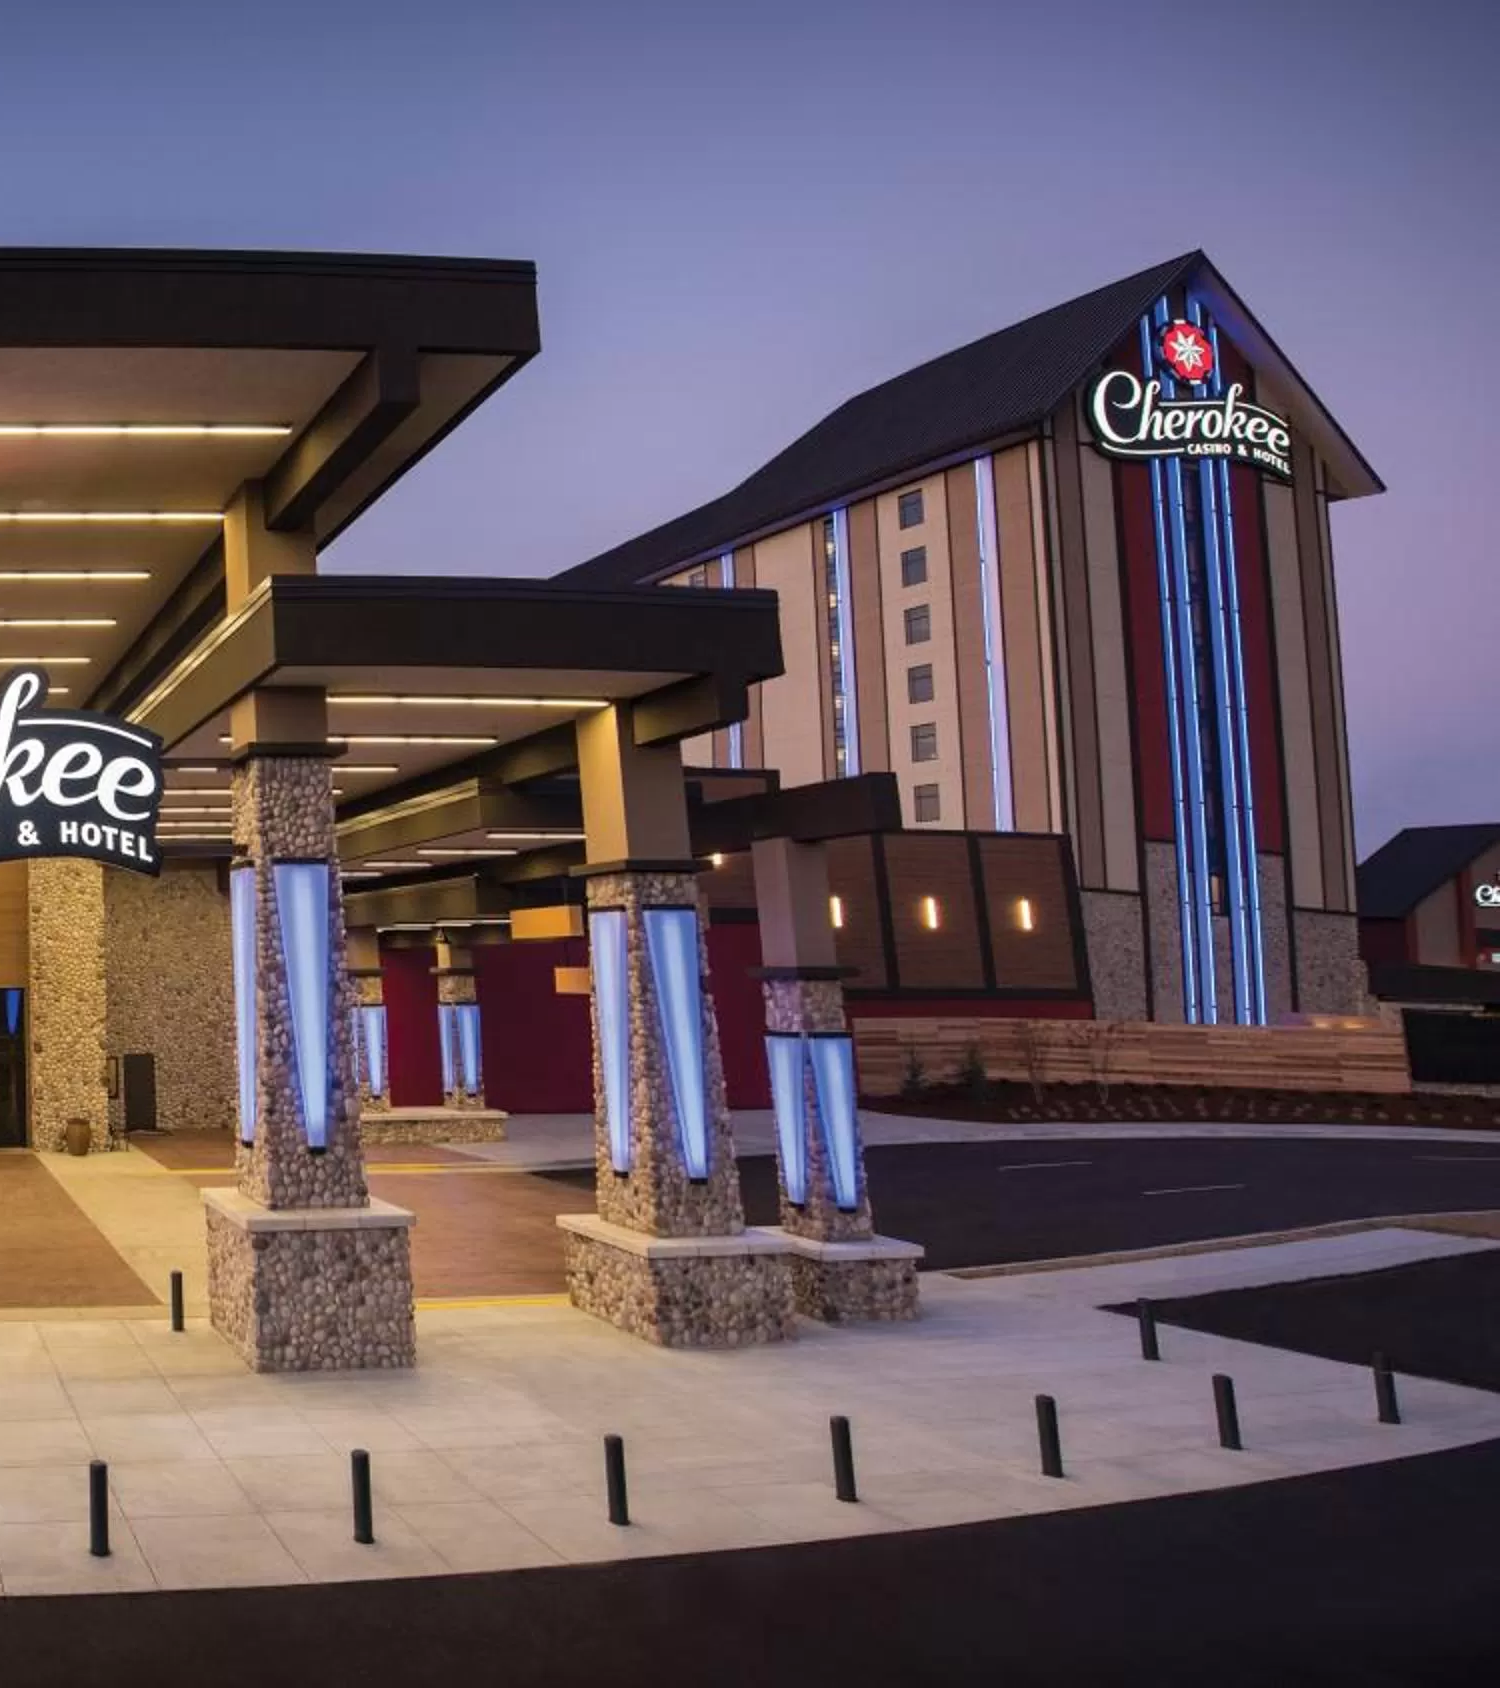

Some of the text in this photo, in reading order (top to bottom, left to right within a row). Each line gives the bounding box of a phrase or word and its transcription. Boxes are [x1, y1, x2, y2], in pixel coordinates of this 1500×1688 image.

[1093, 371, 1290, 456] Cherokee
[1187, 442, 1291, 475] CASINO & HOTEL
[16, 819, 41, 846] &
[59, 820, 154, 863] HOTEL
